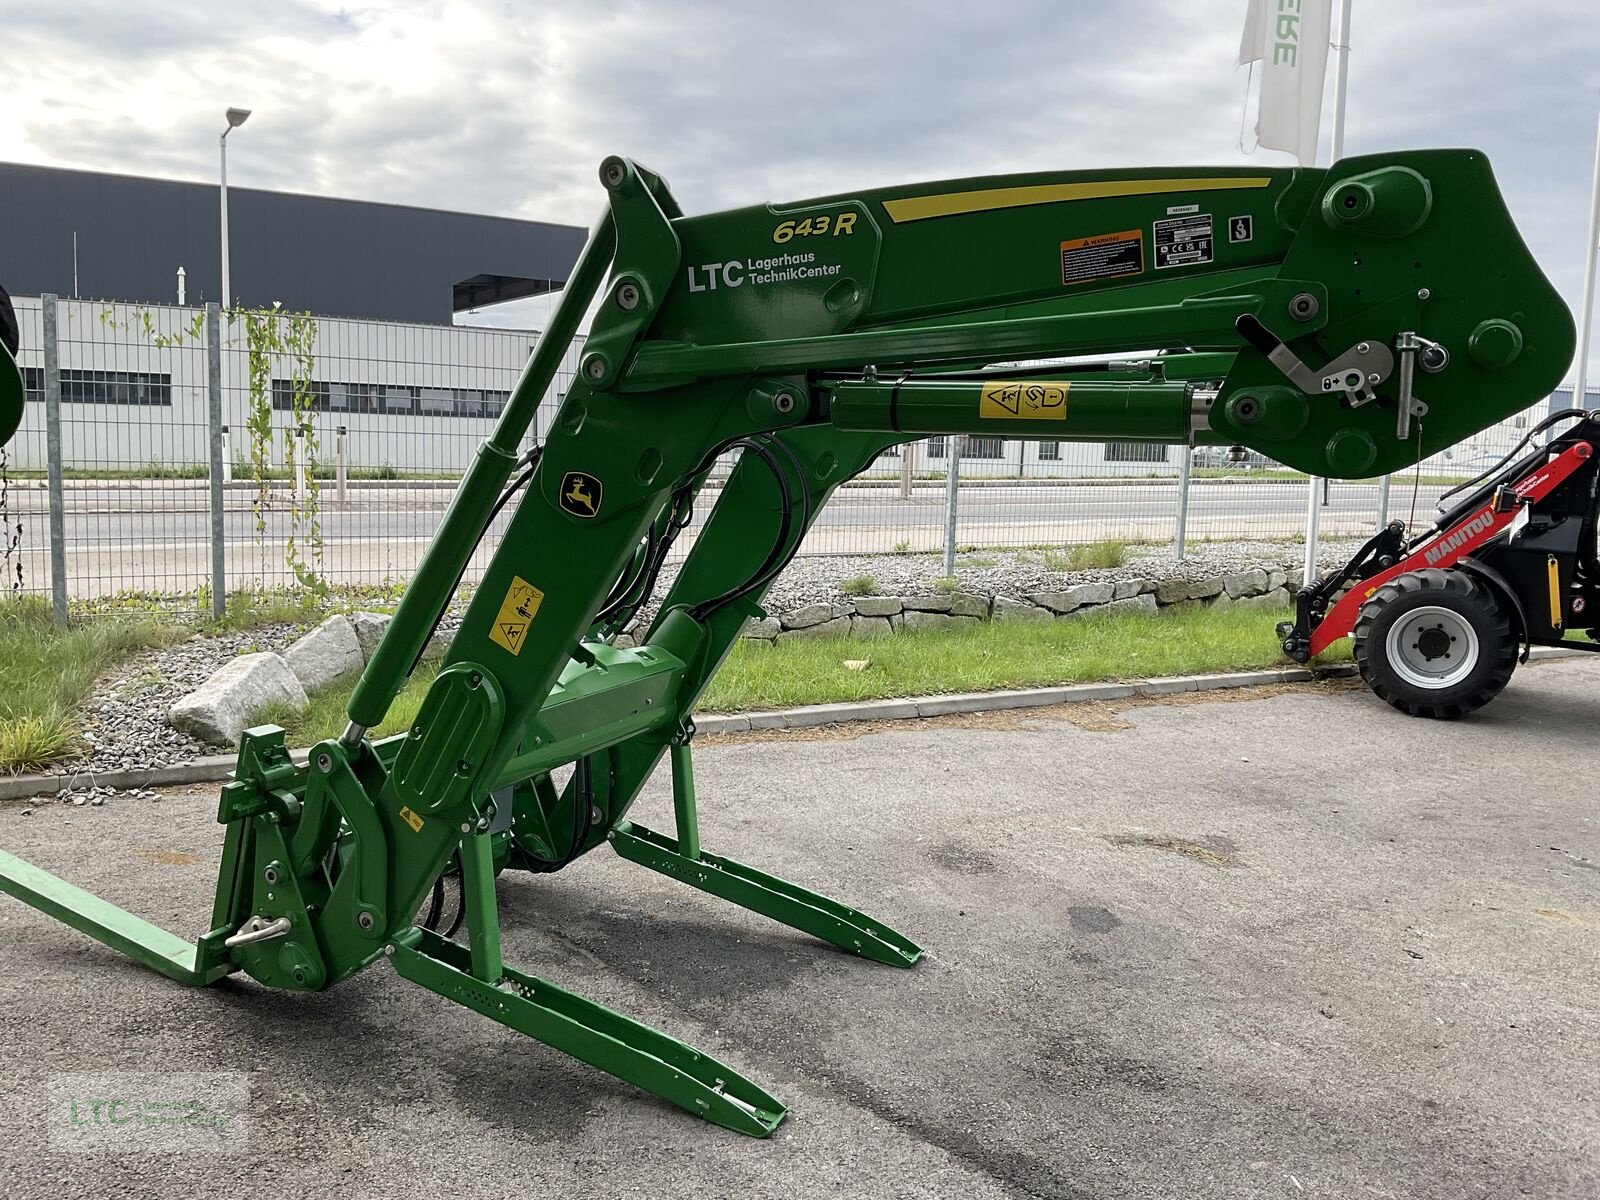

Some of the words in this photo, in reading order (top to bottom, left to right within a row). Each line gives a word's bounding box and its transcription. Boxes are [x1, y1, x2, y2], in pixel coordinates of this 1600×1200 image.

[773, 216, 831, 244] 643
[833, 212, 858, 237] R
[1090, 236, 1120, 245] WARNING
[748, 252, 815, 271] Lagerhaus
[687, 260, 745, 293] LTC
[748, 264, 842, 285] TechnikCenter
[1515, 475, 1538, 493] agerhaus
[1424, 511, 1495, 566] MANITOU
